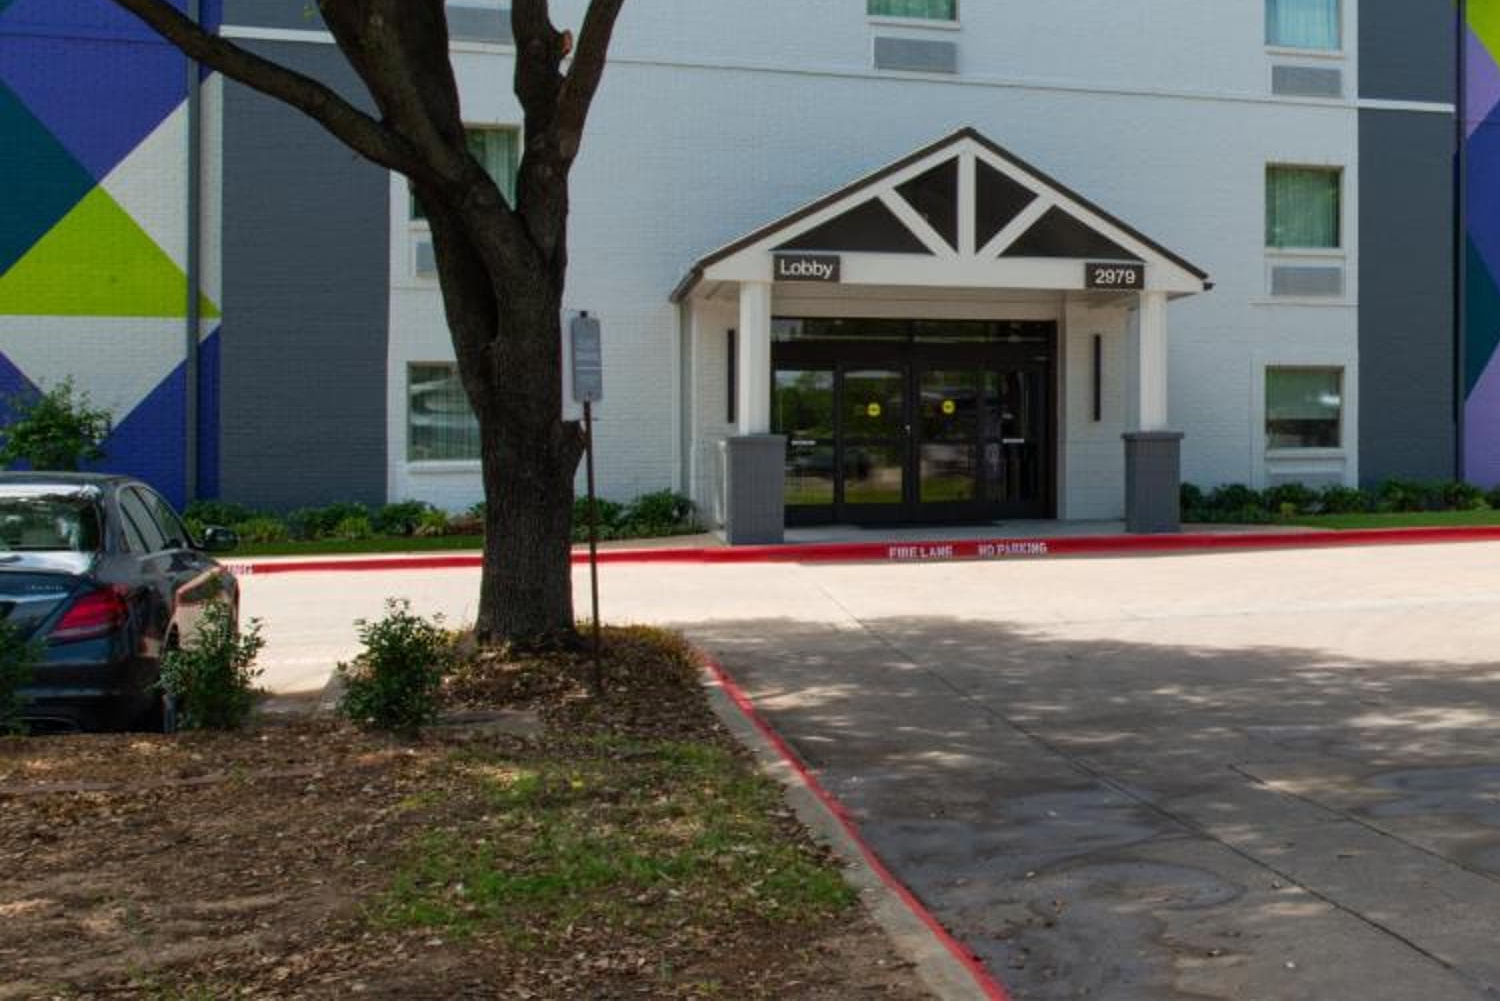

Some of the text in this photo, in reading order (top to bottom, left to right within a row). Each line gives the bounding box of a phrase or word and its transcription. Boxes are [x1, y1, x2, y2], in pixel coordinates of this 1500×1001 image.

[780, 259, 833, 279] Lobby
[1095, 269, 1136, 284] 2979
[889, 546, 918, 559] FIRE
